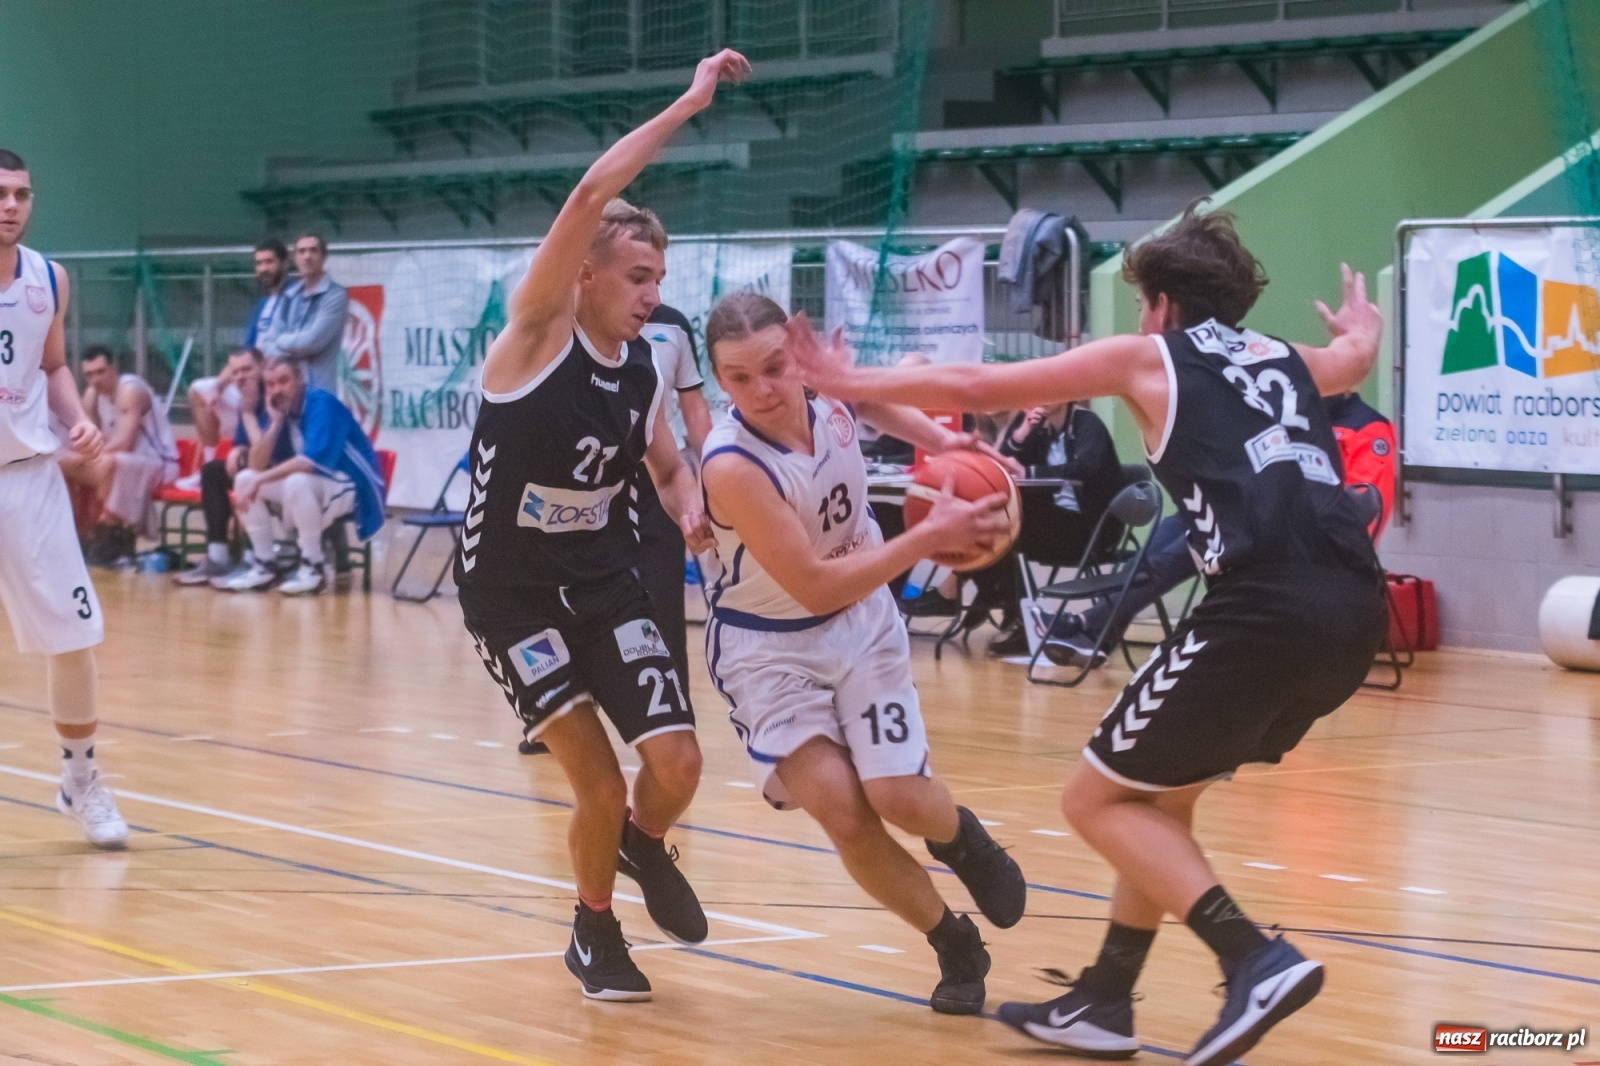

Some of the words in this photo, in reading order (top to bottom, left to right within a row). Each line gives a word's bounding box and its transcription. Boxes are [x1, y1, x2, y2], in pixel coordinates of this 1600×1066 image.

[0, 329, 14, 365] 3
[1436, 385, 1502, 421] powiat
[1434, 423, 1496, 444] zielona
[1506, 430, 1548, 446] oaza
[818, 482, 852, 533] 13
[72, 586, 93, 620] 3
[531, 655, 560, 677] PALIAN
[637, 667, 689, 717] 21
[860, 702, 909, 745] 13
